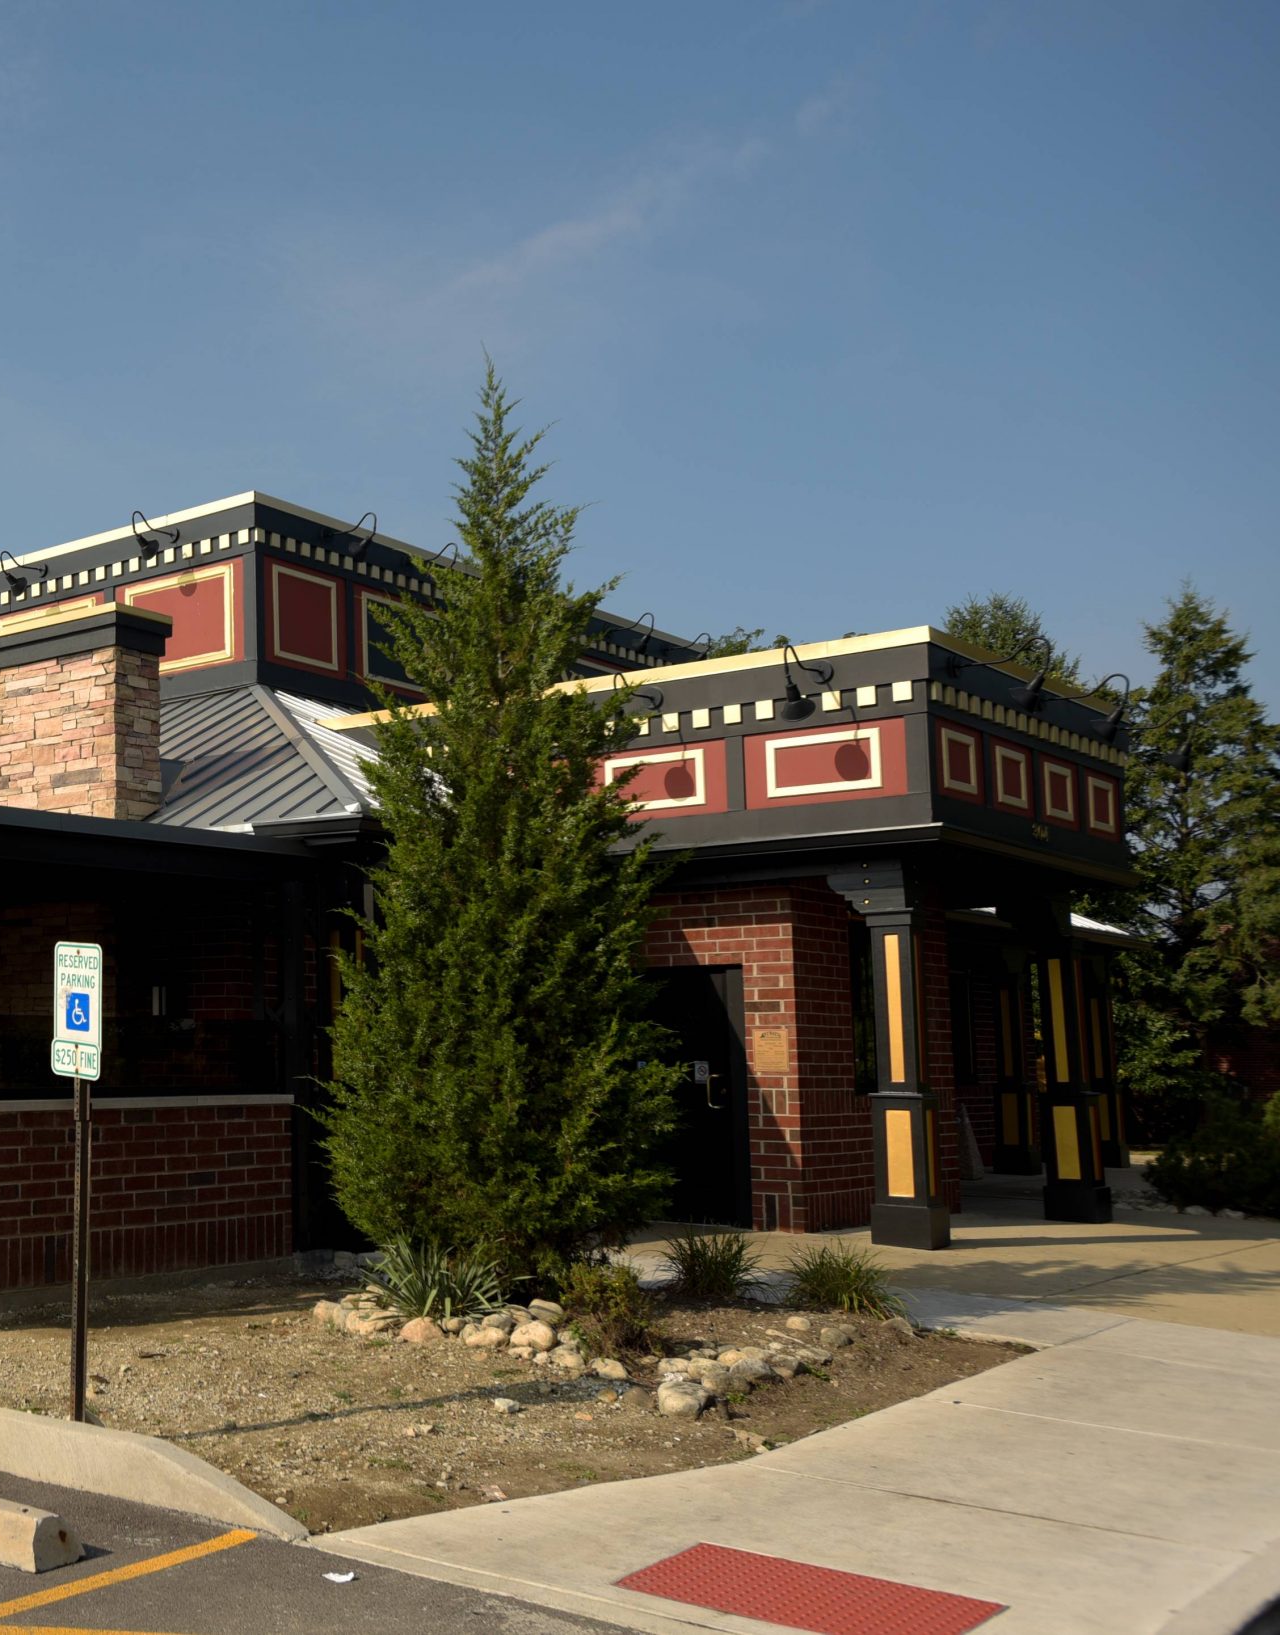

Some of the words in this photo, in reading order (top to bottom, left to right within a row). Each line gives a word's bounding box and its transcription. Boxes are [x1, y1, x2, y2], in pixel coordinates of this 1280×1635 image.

[58, 954, 99, 970] RESERVED
[60, 973, 96, 989] PARKING
[55, 1048, 77, 1066] $250
[79, 1053, 97, 1070] FINE
